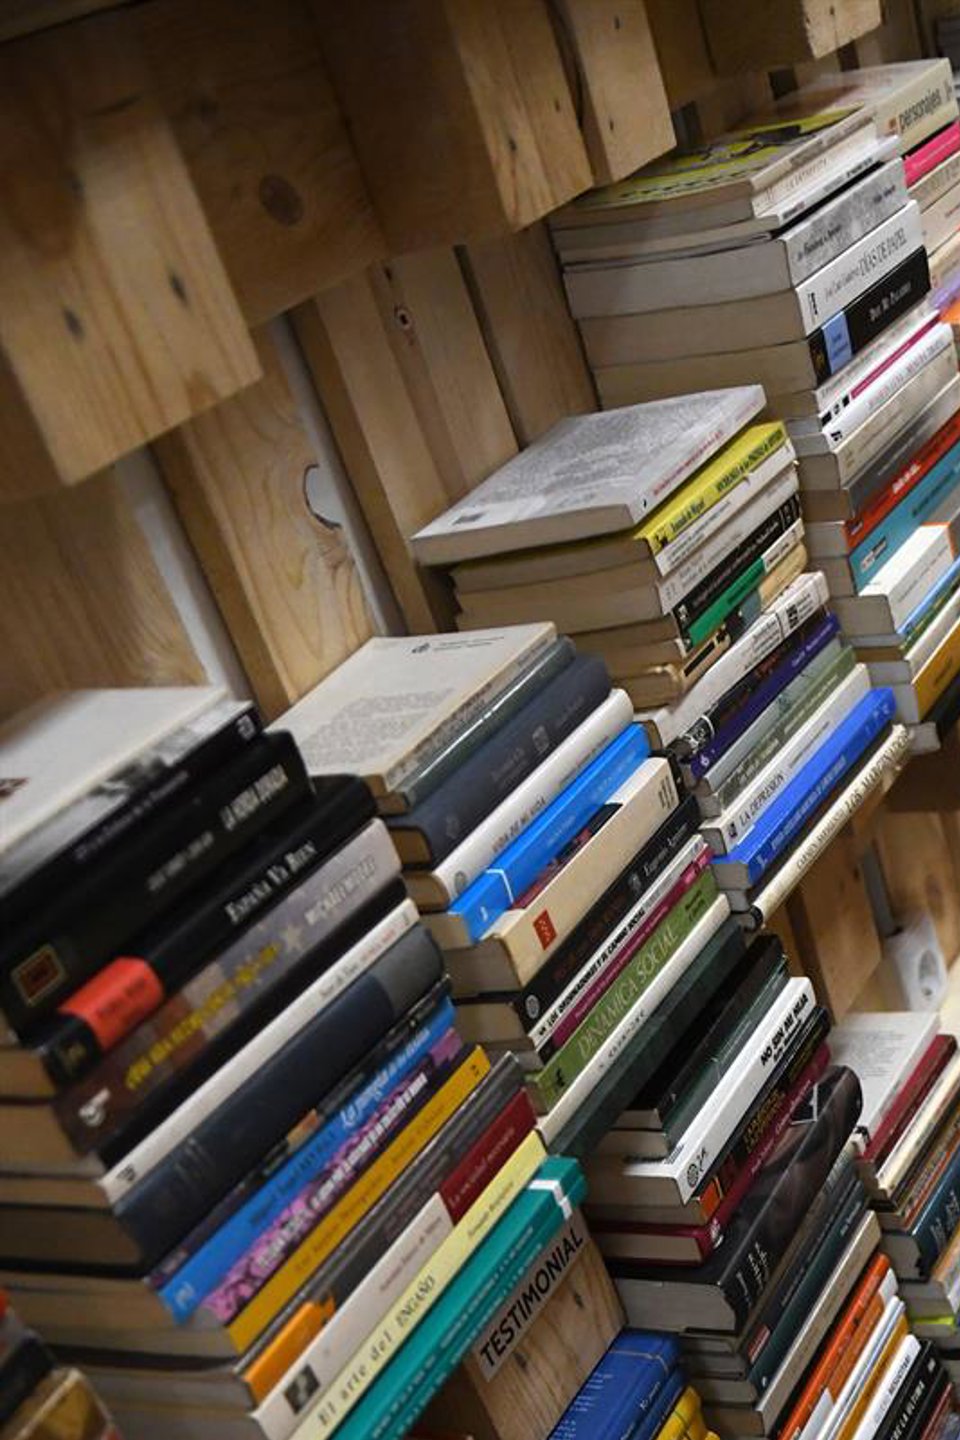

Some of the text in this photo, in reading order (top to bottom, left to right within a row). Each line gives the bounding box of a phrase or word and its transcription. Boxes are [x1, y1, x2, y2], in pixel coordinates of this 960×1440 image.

[480, 1229, 583, 1368] TESTIMONIAL
[341, 1365, 369, 1394] arte
[371, 1332, 393, 1362] del
